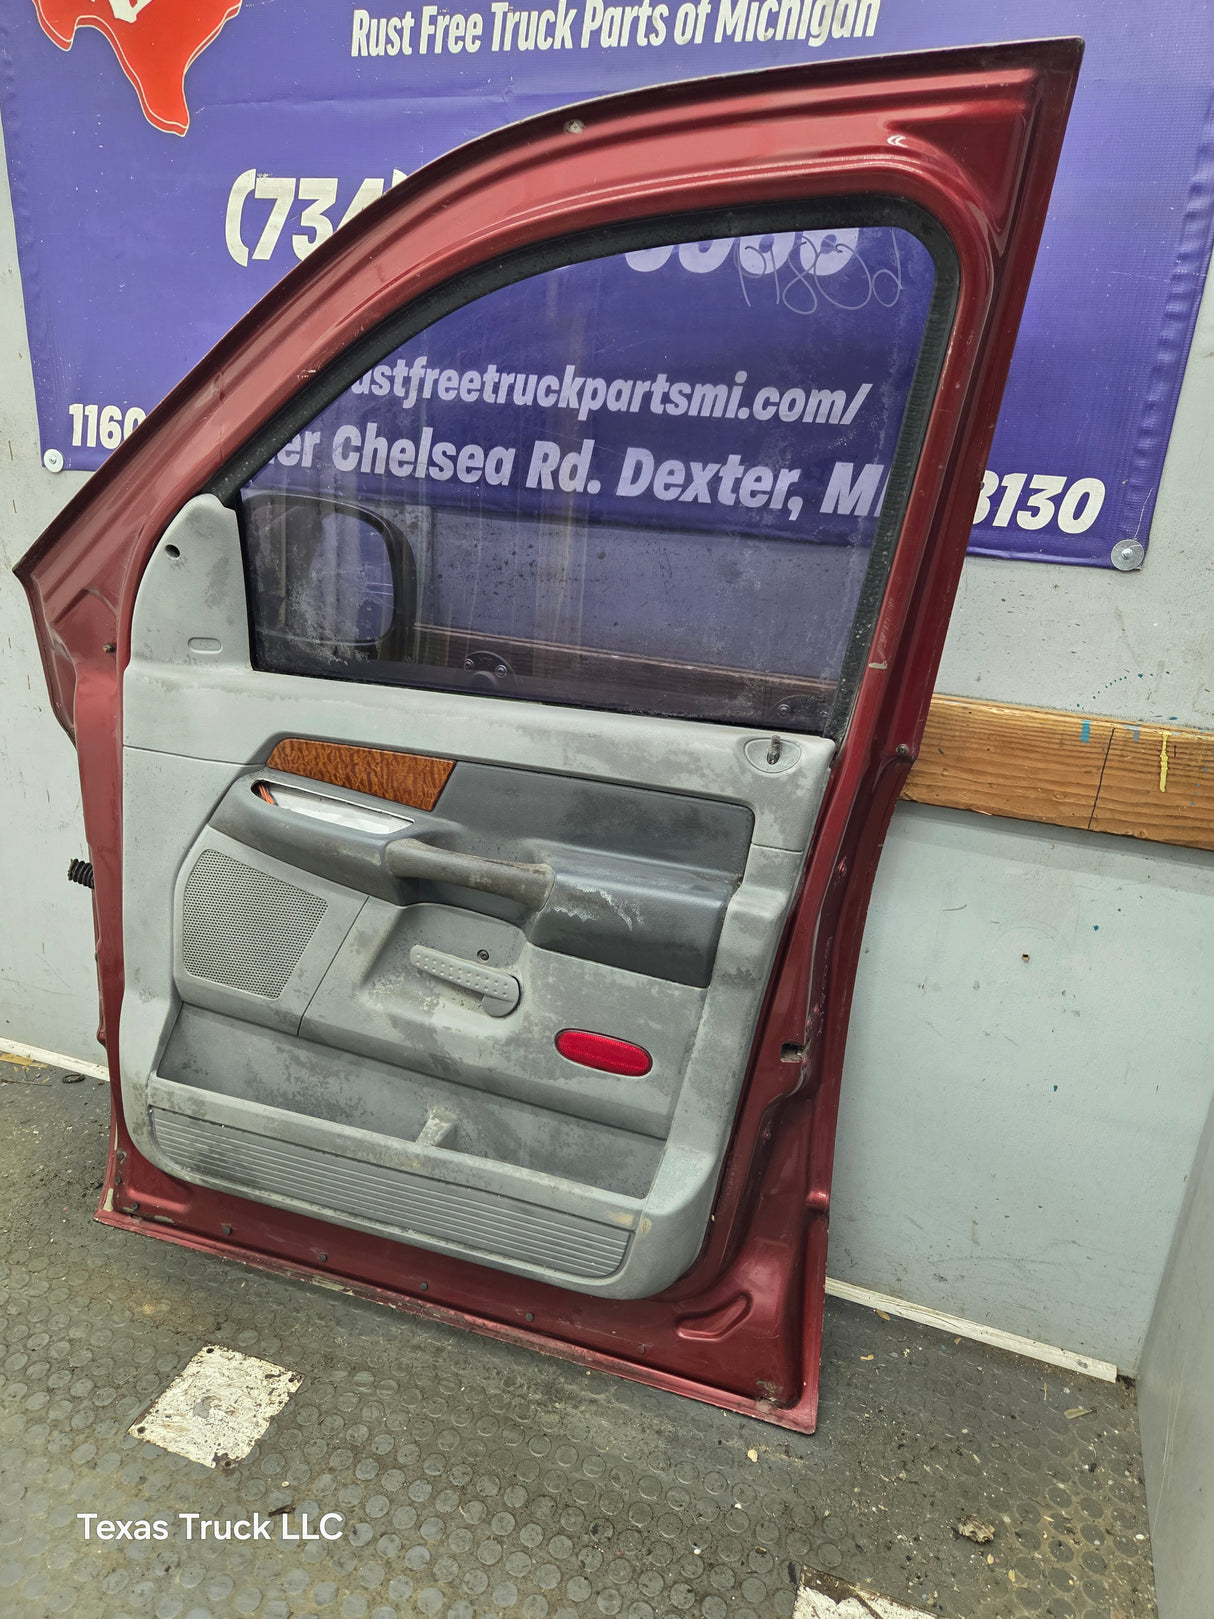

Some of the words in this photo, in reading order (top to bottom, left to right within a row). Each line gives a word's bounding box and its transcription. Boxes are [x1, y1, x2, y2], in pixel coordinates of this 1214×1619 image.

[351, 9, 415, 57] Rust
[419, 5, 483, 54] Free
[491, 0, 577, 52] Truck
[580, 0, 669, 48] Parts
[673, 0, 711, 46] of
[714, 0, 881, 47] Michigan
[225, 168, 408, 267] (73
[268, 431, 321, 467] er
[332, 422, 518, 486] Chelsea
[525, 439, 602, 494] Rd.
[616, 447, 804, 521] Dexter,
